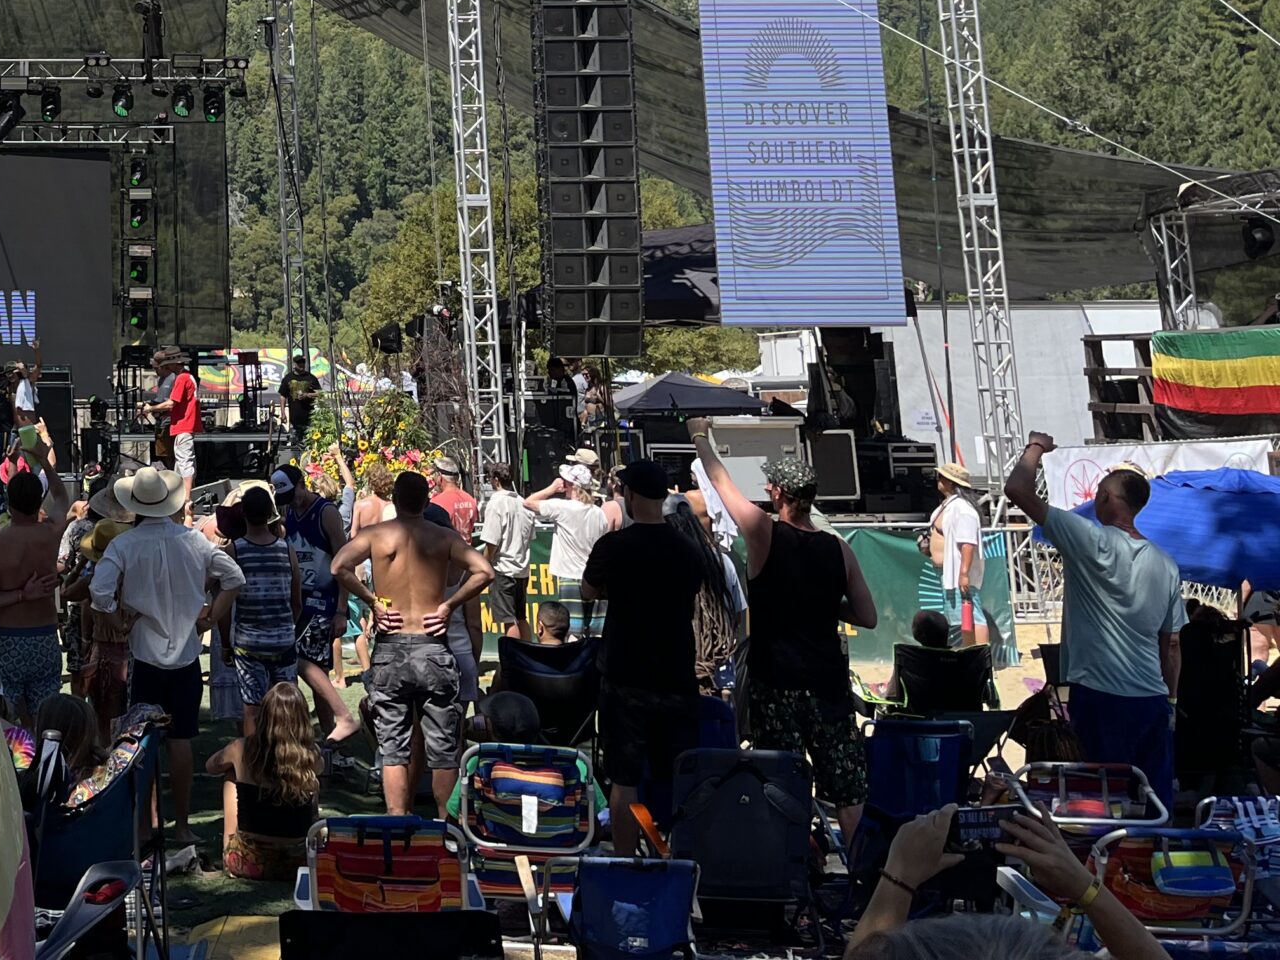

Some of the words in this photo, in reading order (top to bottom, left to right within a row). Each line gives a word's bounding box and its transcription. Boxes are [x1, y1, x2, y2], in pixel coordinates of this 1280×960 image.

[744, 102, 850, 125] DISCOVER
[747, 141, 853, 164] SOUTHERN
[750, 179, 854, 202] HUMBOLDT
